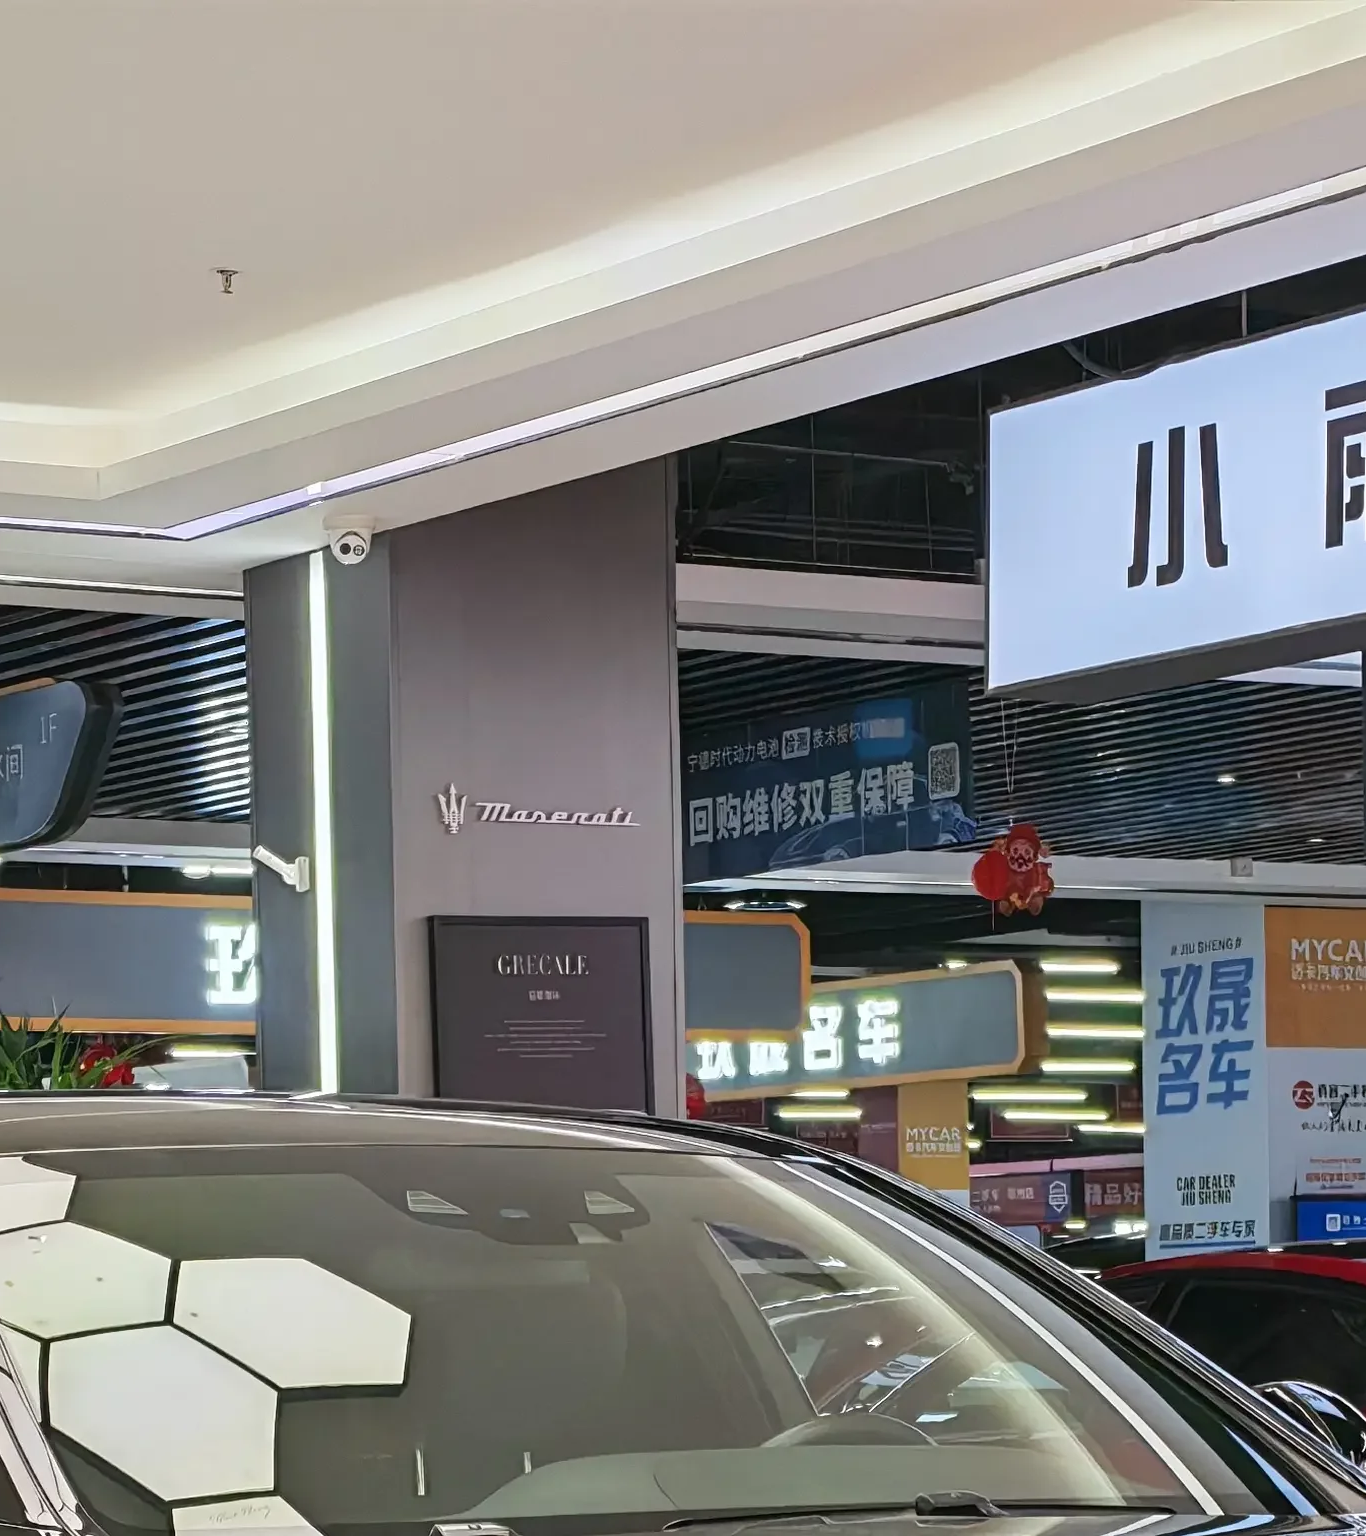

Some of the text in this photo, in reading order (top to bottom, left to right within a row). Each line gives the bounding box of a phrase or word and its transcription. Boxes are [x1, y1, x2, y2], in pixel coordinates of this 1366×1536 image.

[39, 712, 58, 744] 1F
[474, 801, 641, 827] Maserati
[689, 761, 915, 846] 回购维修双重保障
[497, 954, 589, 975] GRECALE
[1155, 957, 1254, 1039] 玖晟
[1156, 1039, 1254, 1116] 名车
[905, 1126, 961, 1142] MYCAR
[1176, 1173, 1236, 1192] CAR DEALER
